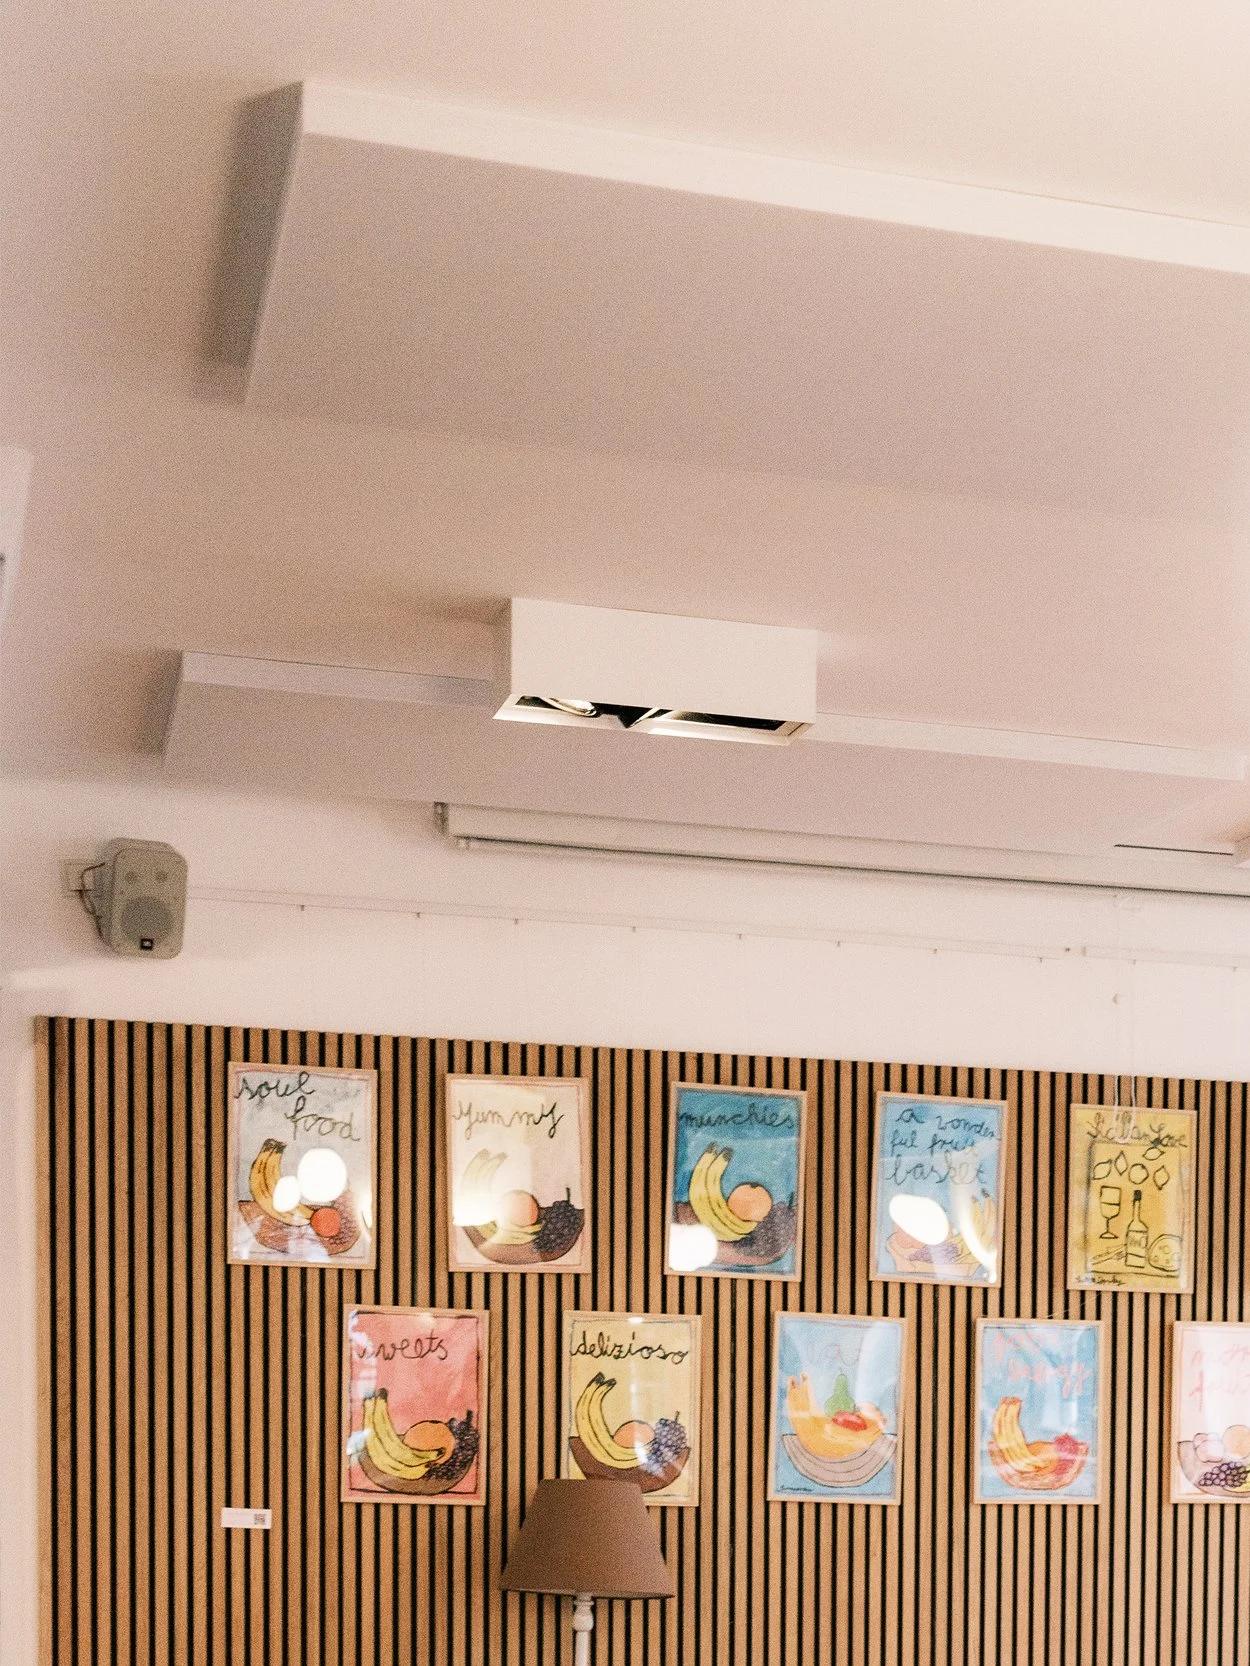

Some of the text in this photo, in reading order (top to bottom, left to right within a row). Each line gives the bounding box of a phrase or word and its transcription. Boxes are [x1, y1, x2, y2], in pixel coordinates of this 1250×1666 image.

[284, 1096, 361, 1142] food
[680, 1103, 796, 1129] munchies
[570, 1331, 689, 1364] delizioso
